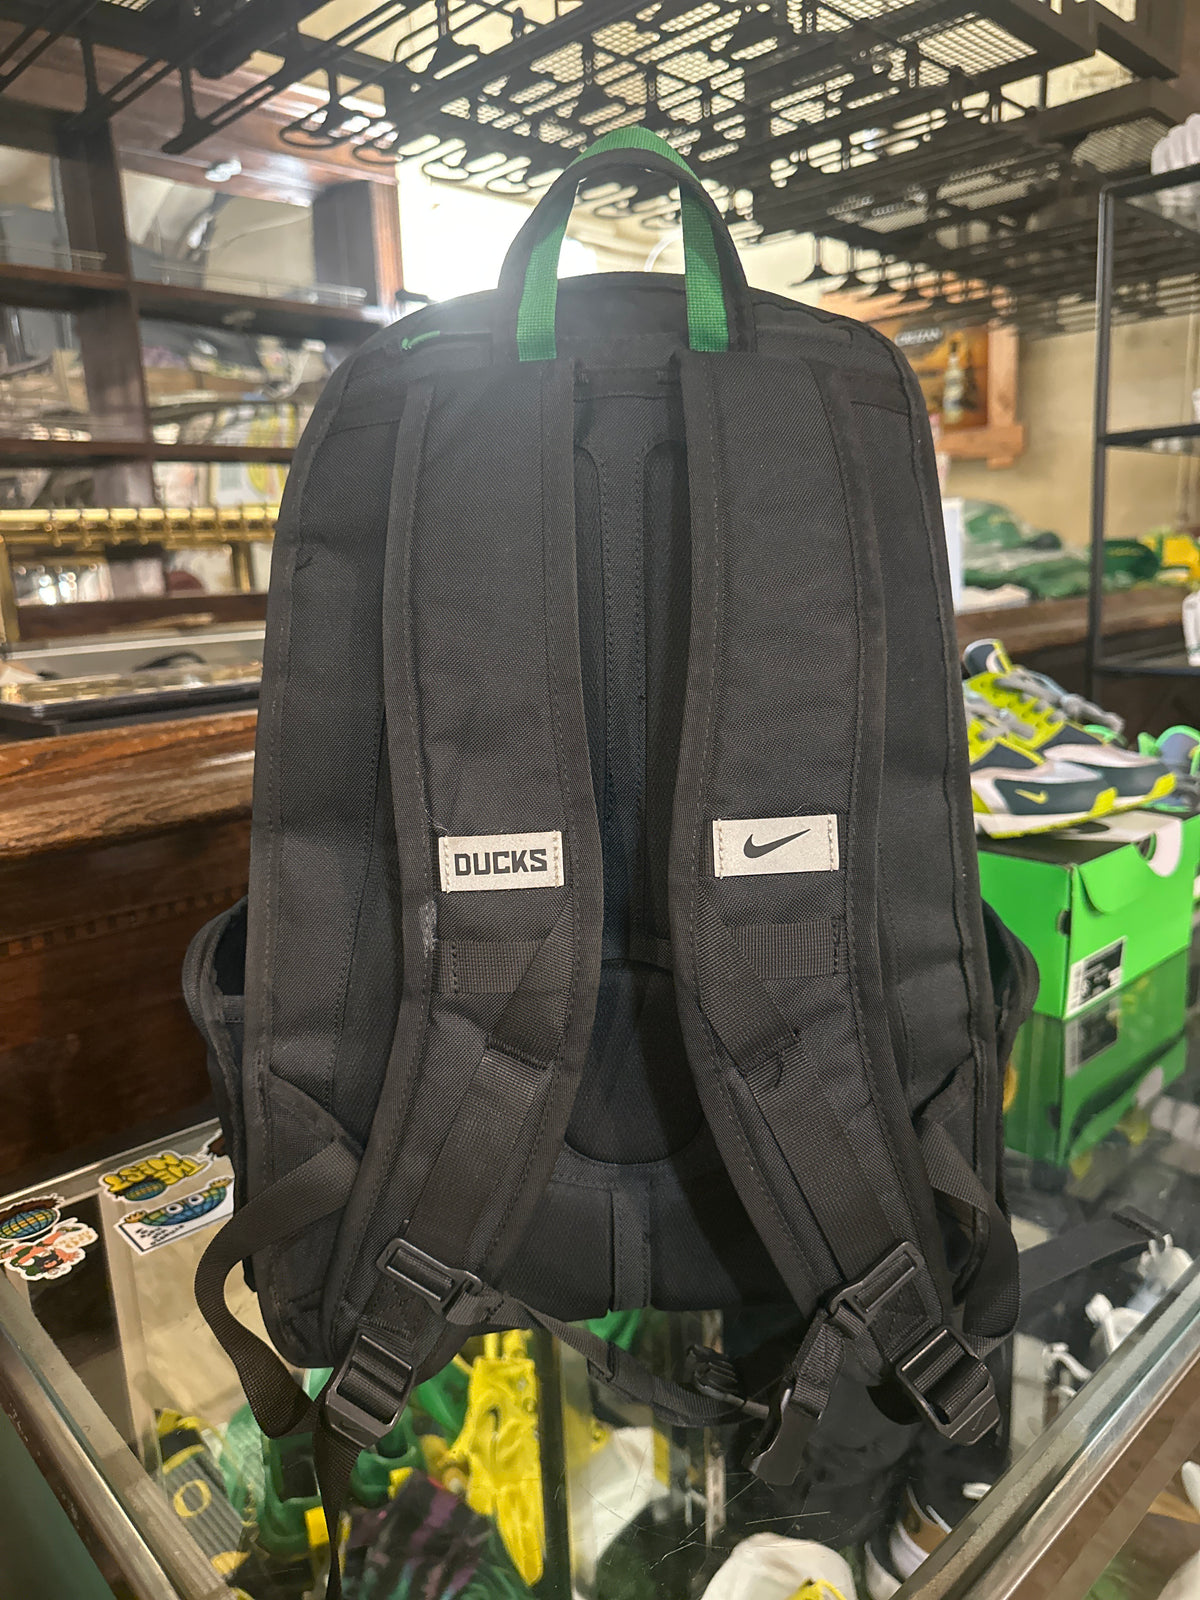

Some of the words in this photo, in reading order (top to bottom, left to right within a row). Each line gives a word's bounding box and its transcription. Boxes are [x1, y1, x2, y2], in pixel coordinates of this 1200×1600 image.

[454, 848, 548, 877] DUCKS
[103, 1153, 180, 1193] NEST
[154, 1157, 208, 1186] THE
[173, 1479, 212, 1518] O
